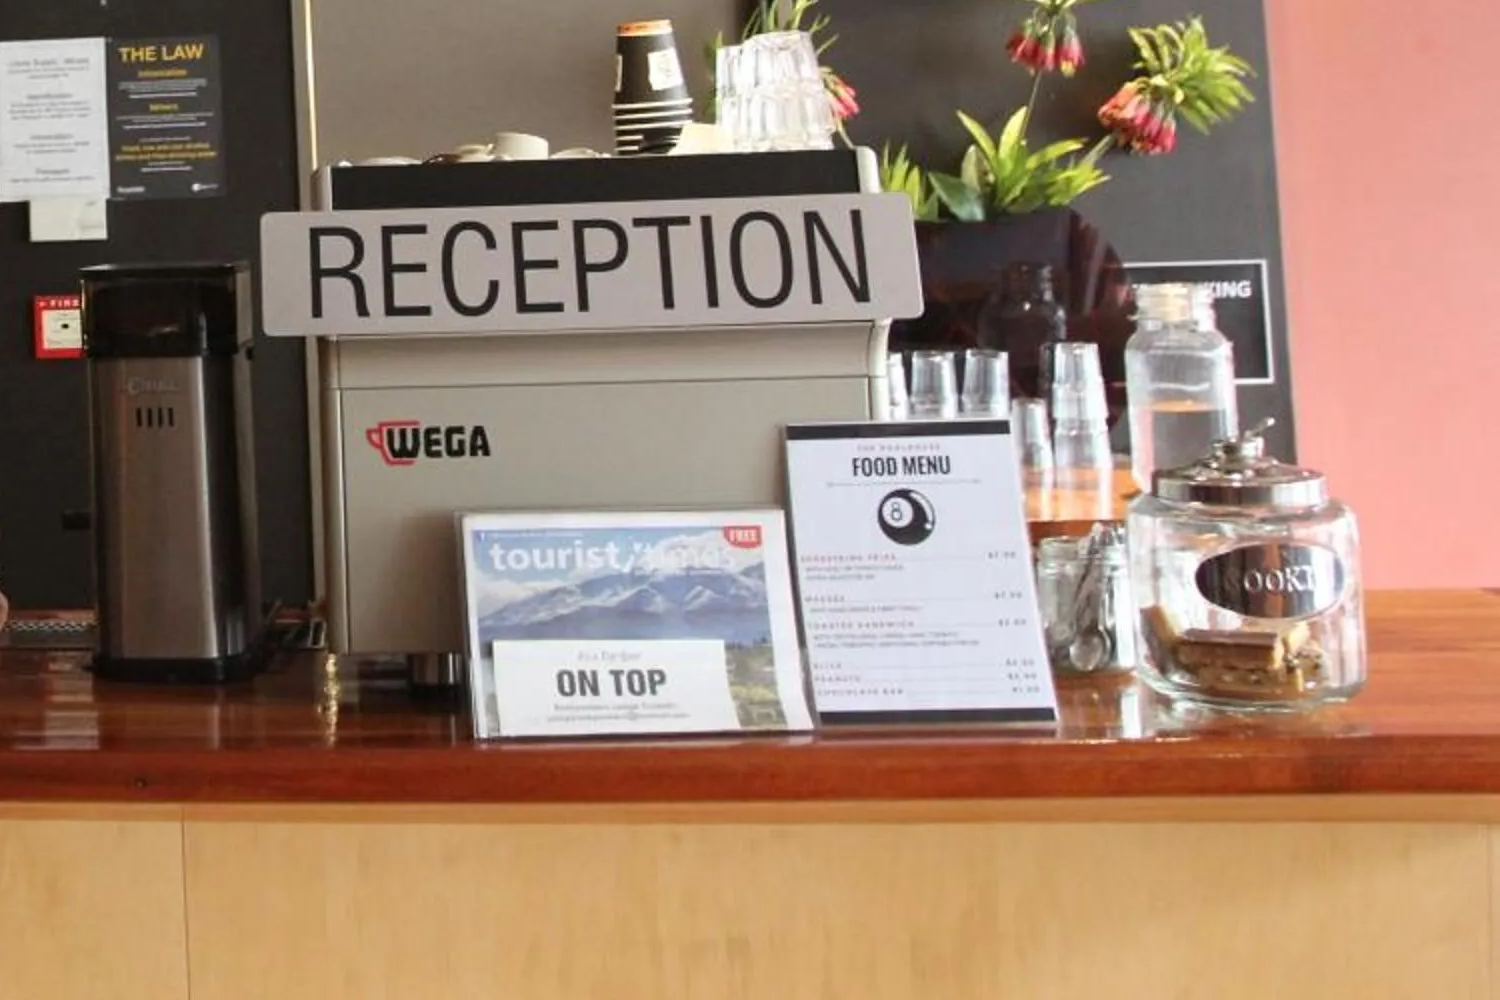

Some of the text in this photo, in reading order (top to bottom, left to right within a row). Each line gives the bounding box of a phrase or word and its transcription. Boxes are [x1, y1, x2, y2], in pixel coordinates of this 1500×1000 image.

[118, 43, 204, 63] THE LAW
[308, 209, 871, 319] RECEPTION
[386, 424, 490, 461] WEGA
[852, 455, 951, 477] FOOD MENU
[728, 529, 758, 543] FREE
[557, 668, 667, 697] ON TOP
